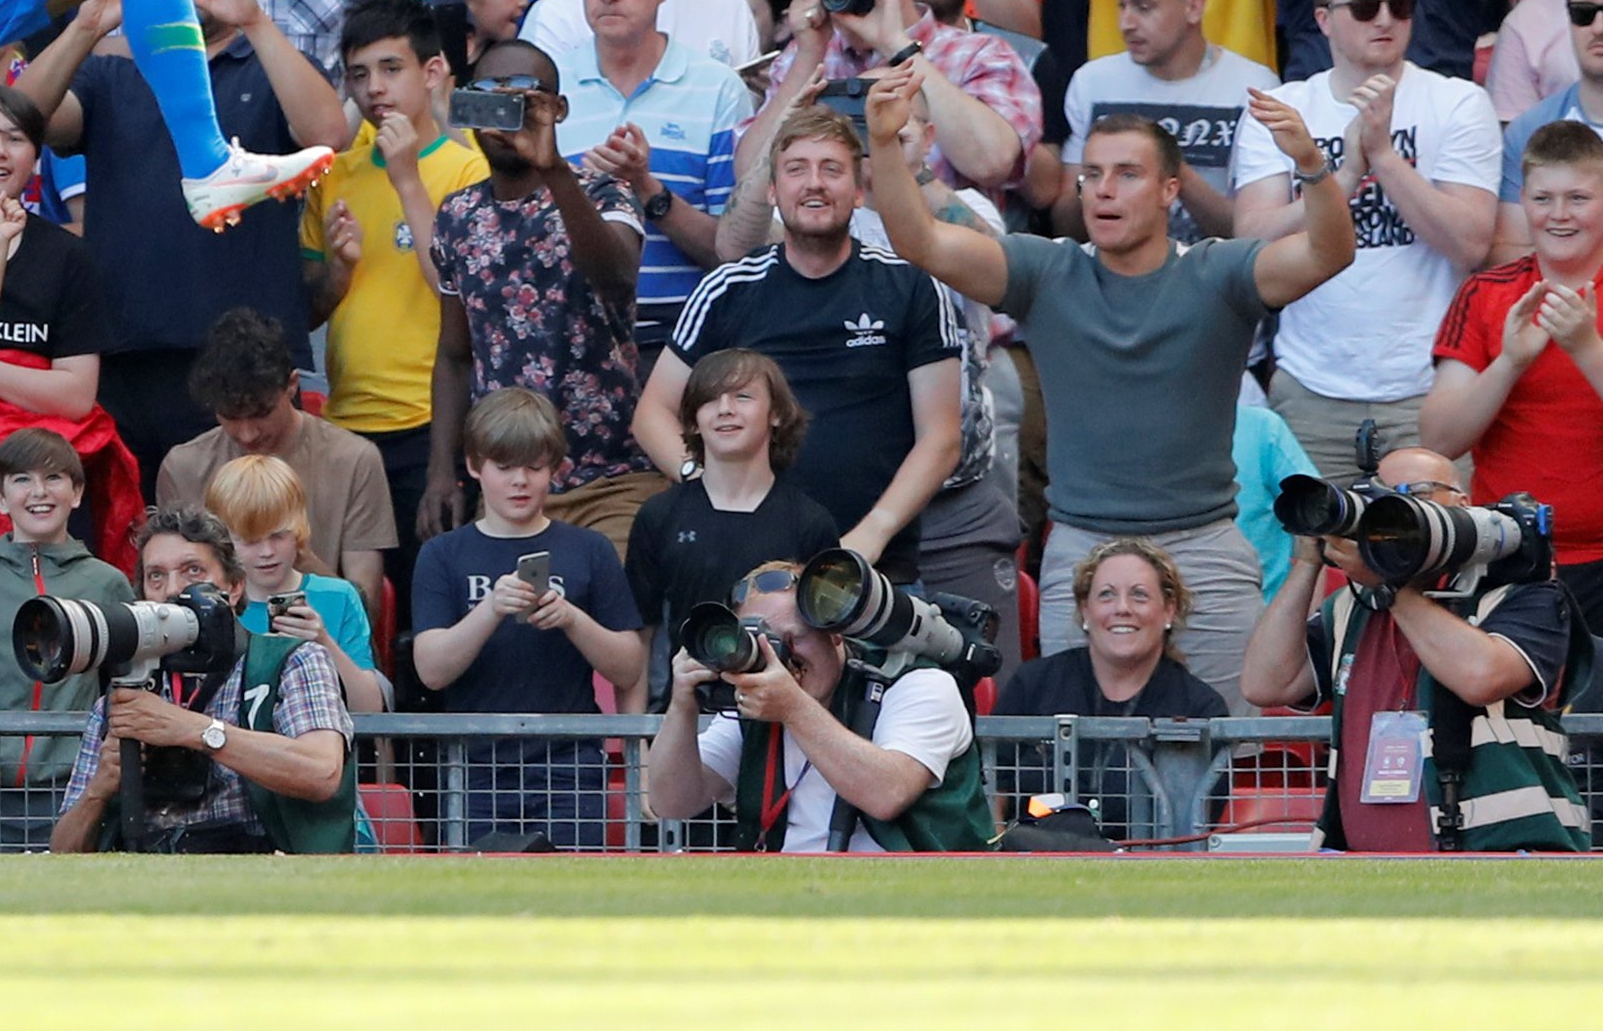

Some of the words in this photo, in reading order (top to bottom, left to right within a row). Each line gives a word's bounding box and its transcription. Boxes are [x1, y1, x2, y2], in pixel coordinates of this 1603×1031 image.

[1355, 225, 1415, 249] SLAND
[846, 335, 886, 348] adidas
[466, 574, 566, 601] BS
